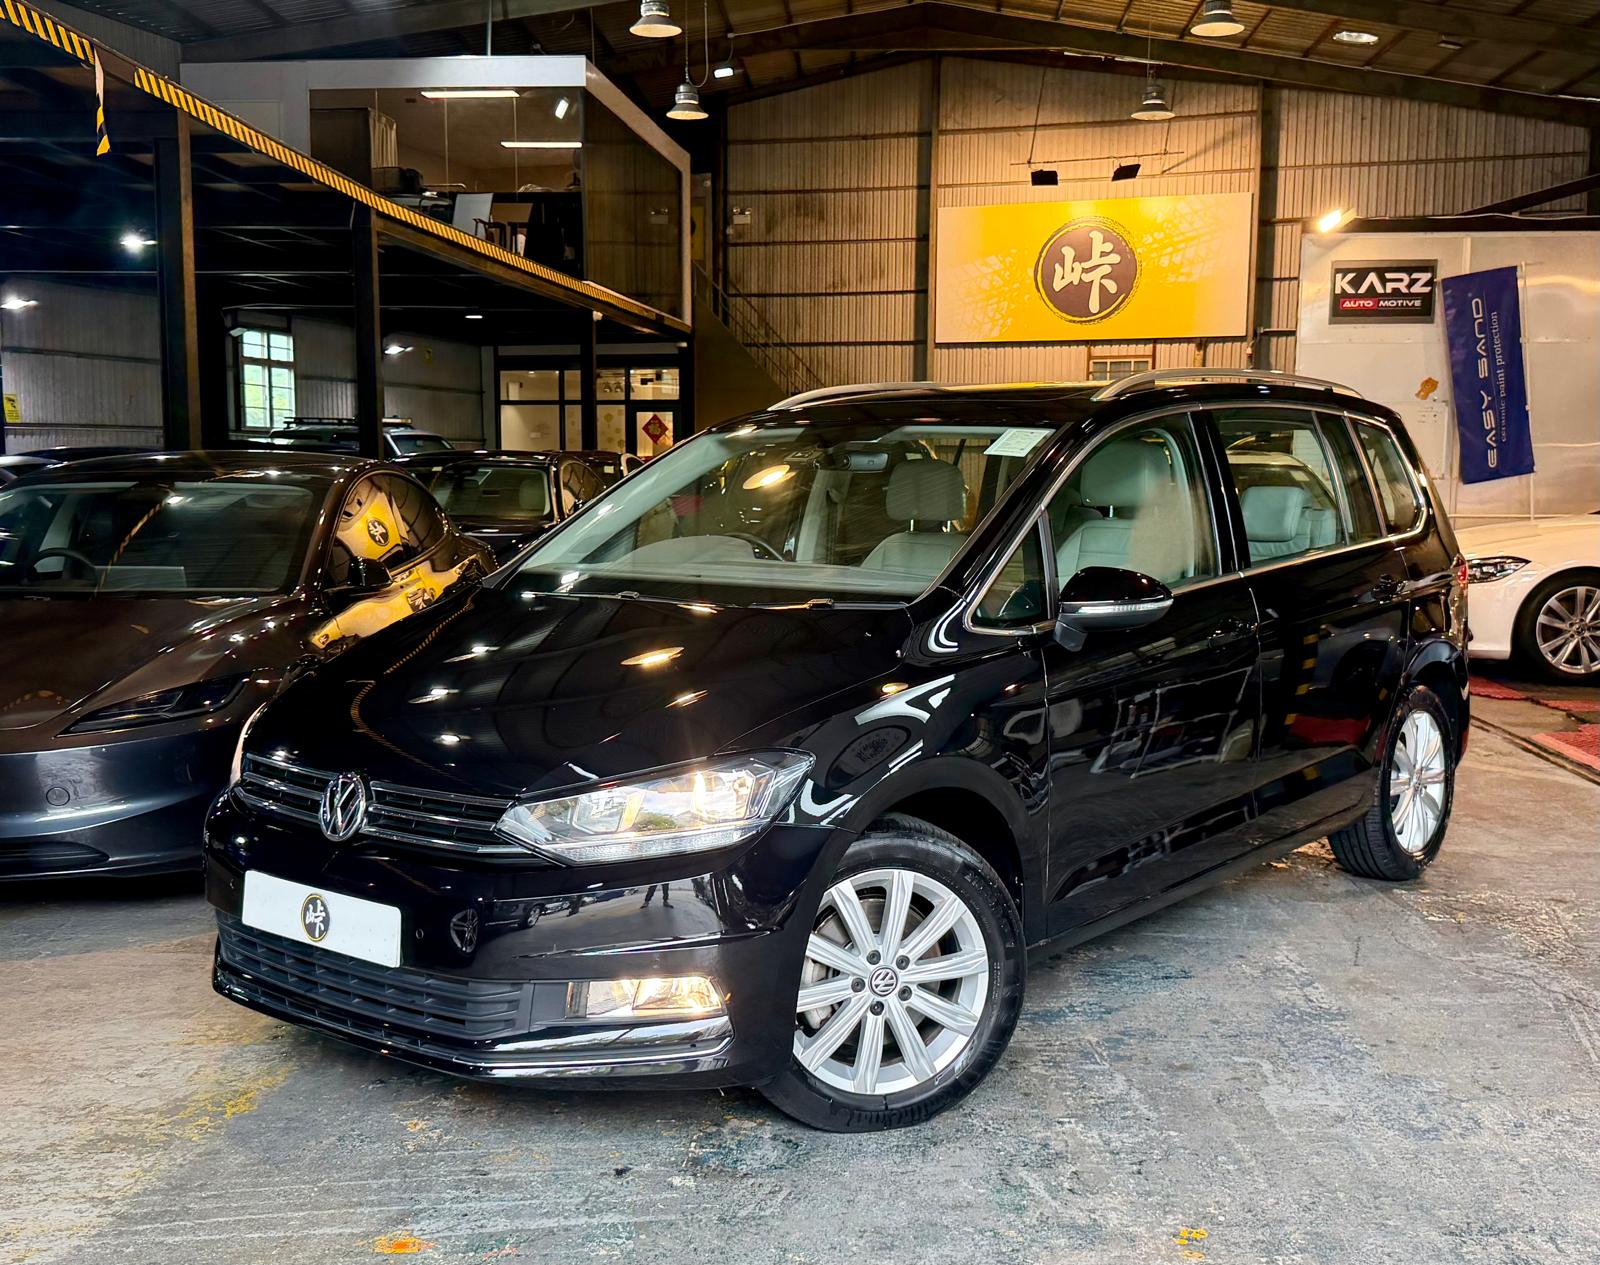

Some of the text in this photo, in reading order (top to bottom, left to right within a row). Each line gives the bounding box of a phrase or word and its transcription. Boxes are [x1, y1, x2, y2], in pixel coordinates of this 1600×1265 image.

[1053, 230, 1121, 314] 峠
[1335, 272, 1432, 294] KARZ
[1342, 300, 1374, 308] AUTO
[1490, 311, 1504, 365] protection
[1471, 298, 1497, 468] EASY SAND
[1496, 367, 1505, 397] paint
[305, 900, 326, 938] 峠
